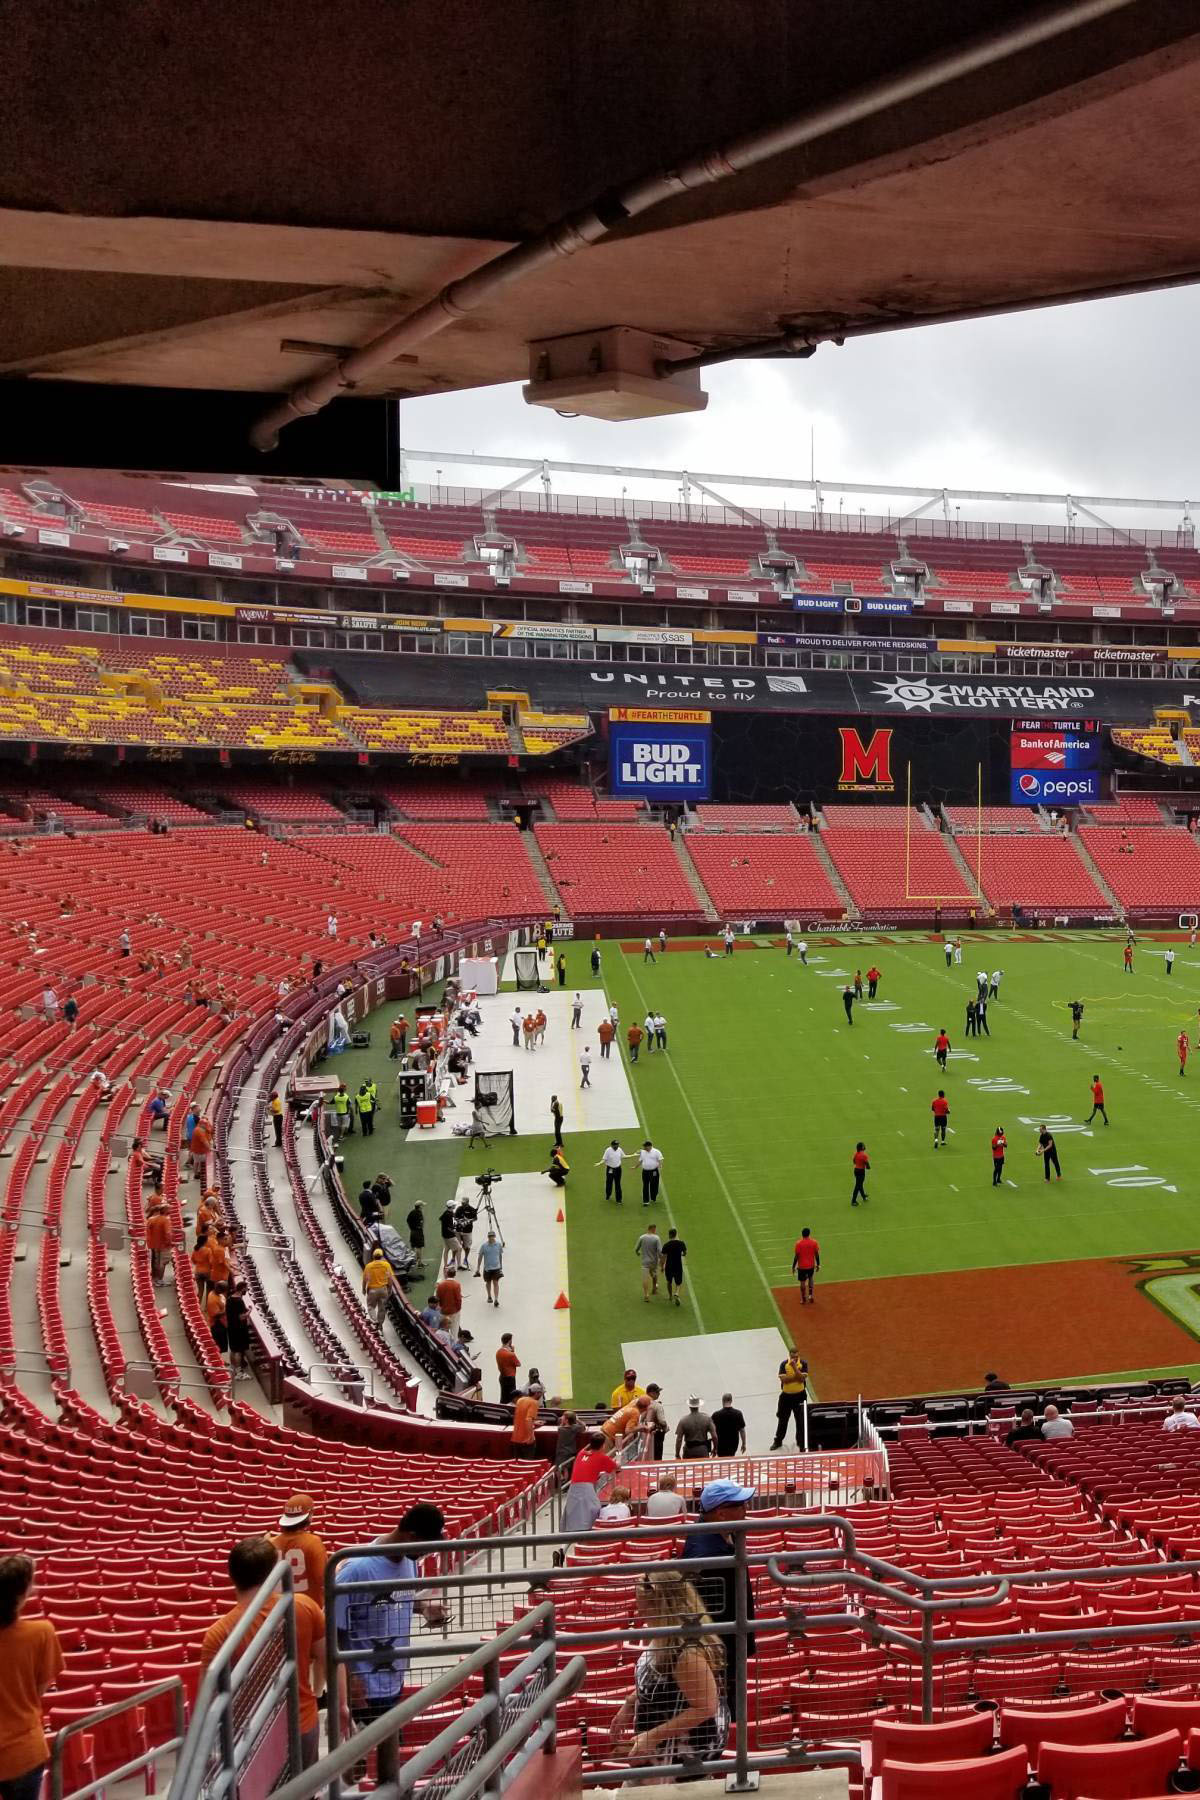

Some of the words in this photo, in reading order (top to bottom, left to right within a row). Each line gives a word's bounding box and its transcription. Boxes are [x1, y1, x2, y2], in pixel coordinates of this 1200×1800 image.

[798, 599, 815, 607] BUD
[815, 600, 839, 608] LIGHT
[867, 602, 884, 610] BUD
[885, 603, 908, 611] LIGHT
[668, 633, 685, 642] sas
[767, 636, 785, 644] FedEx
[795, 637, 820, 646] PROUD
[821, 638, 831, 646] TO
[832, 639, 862, 647] DELIVER
[863, 640, 876, 648] FOR
[877, 640, 892, 648] THE
[892, 641, 929, 649] REDSKINS.
[1007, 647, 1070, 659] ticketmaster
[1093, 649, 1155, 660] ticketmaster
[590, 672, 756, 688] UNITED
[646, 689, 701, 700] Proud
[708, 691, 720, 700] to
[733, 692, 756, 701] fly
[948, 684, 1095, 698] MARYLAND
[632, 711, 704, 721] #FEARTHETURTLE
[1020, 738, 1044, 748] Bank
[1044, 739, 1053, 748] of
[1053, 739, 1090, 749] America
[633, 743, 690, 763] BUD
[838, 727, 894, 783] M
[621, 763, 701, 783] LIGHT
[1043, 778, 1094, 797] pepsi
[807, 921, 852, 933] Charitable
[851, 921, 897, 932] Foundation
[1088, 1164, 1168, 1188] 10
